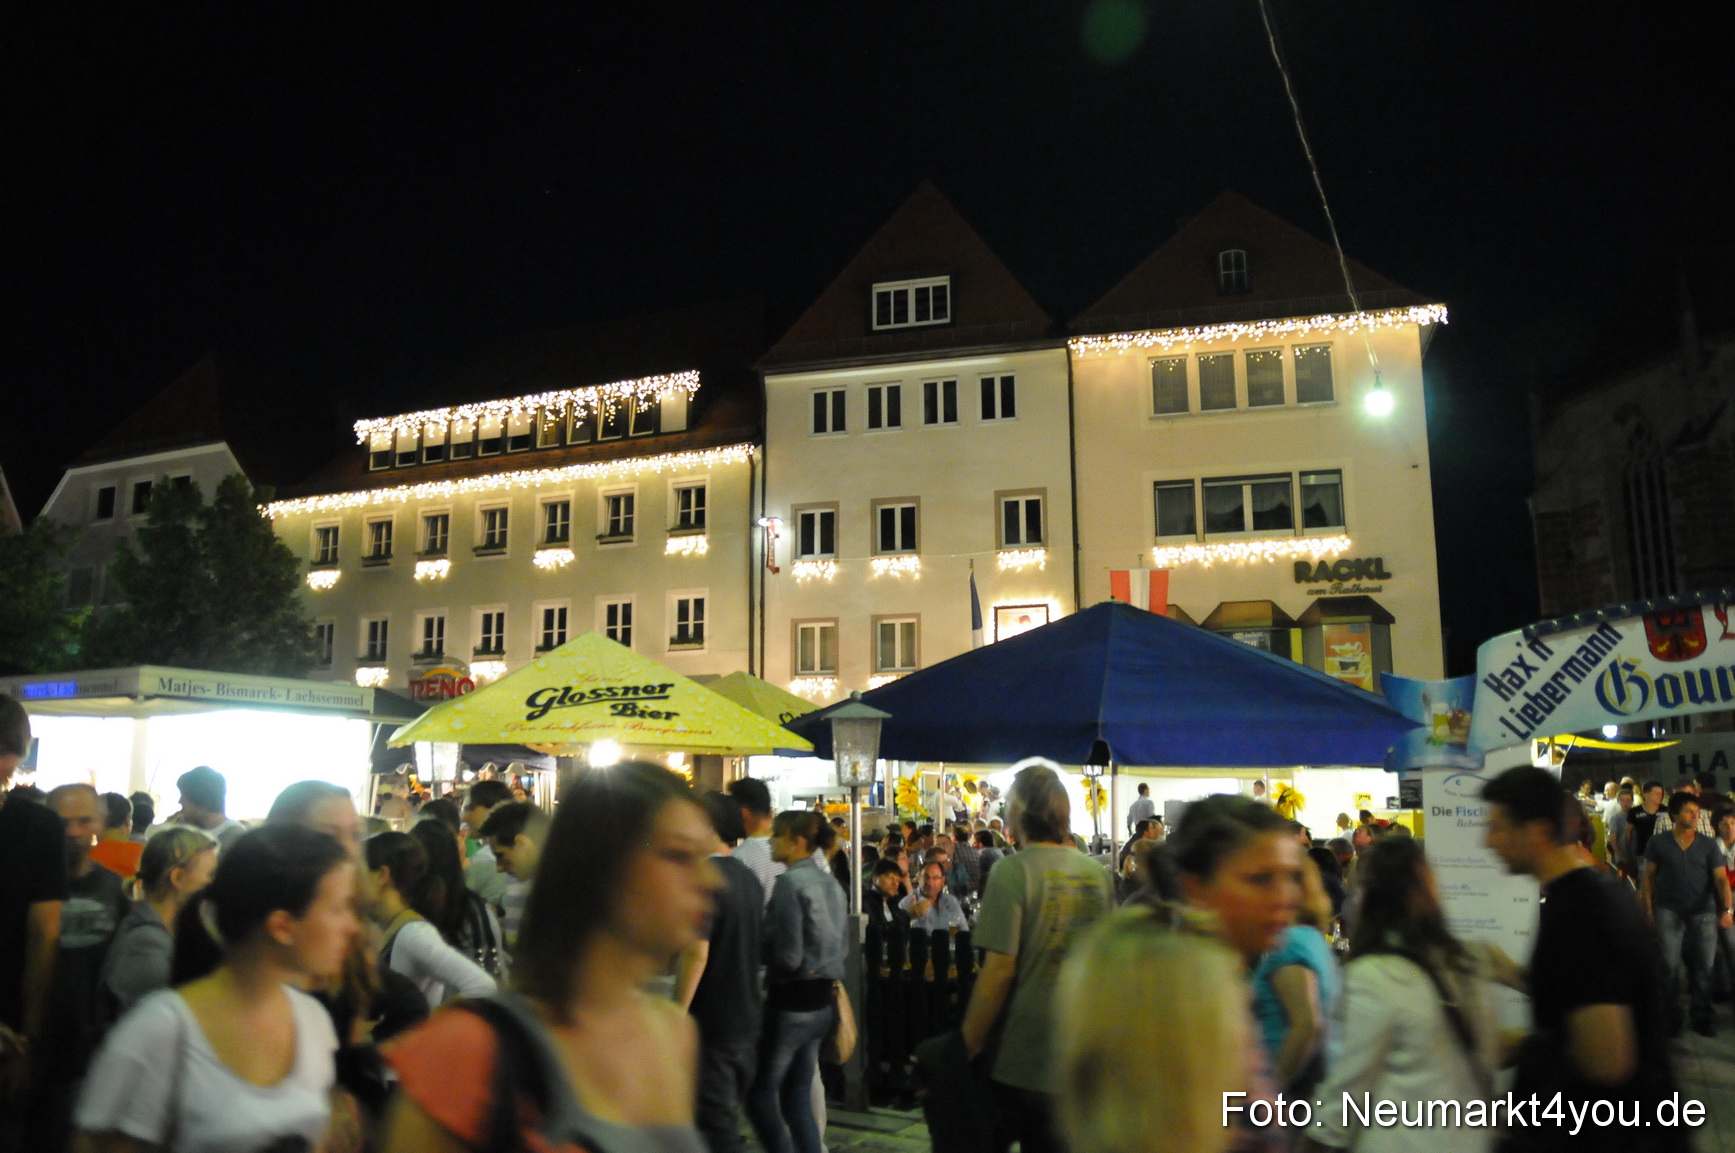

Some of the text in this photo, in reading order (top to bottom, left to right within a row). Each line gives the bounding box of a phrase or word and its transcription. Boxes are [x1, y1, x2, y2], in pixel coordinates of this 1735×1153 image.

[1294, 558, 1392, 583] RACKL
[1329, 582, 1383, 595] Rathaus
[1483, 636, 1555, 702] Hax'n
[409, 677, 476, 698] RENO
[1499, 621, 1624, 740] Liebermann
[286, 688, 363, 707] Lachssemmel
[526, 683, 675, 721] Glossner
[610, 702, 680, 721] Bier
[1432, 806, 1453, 817] Die
